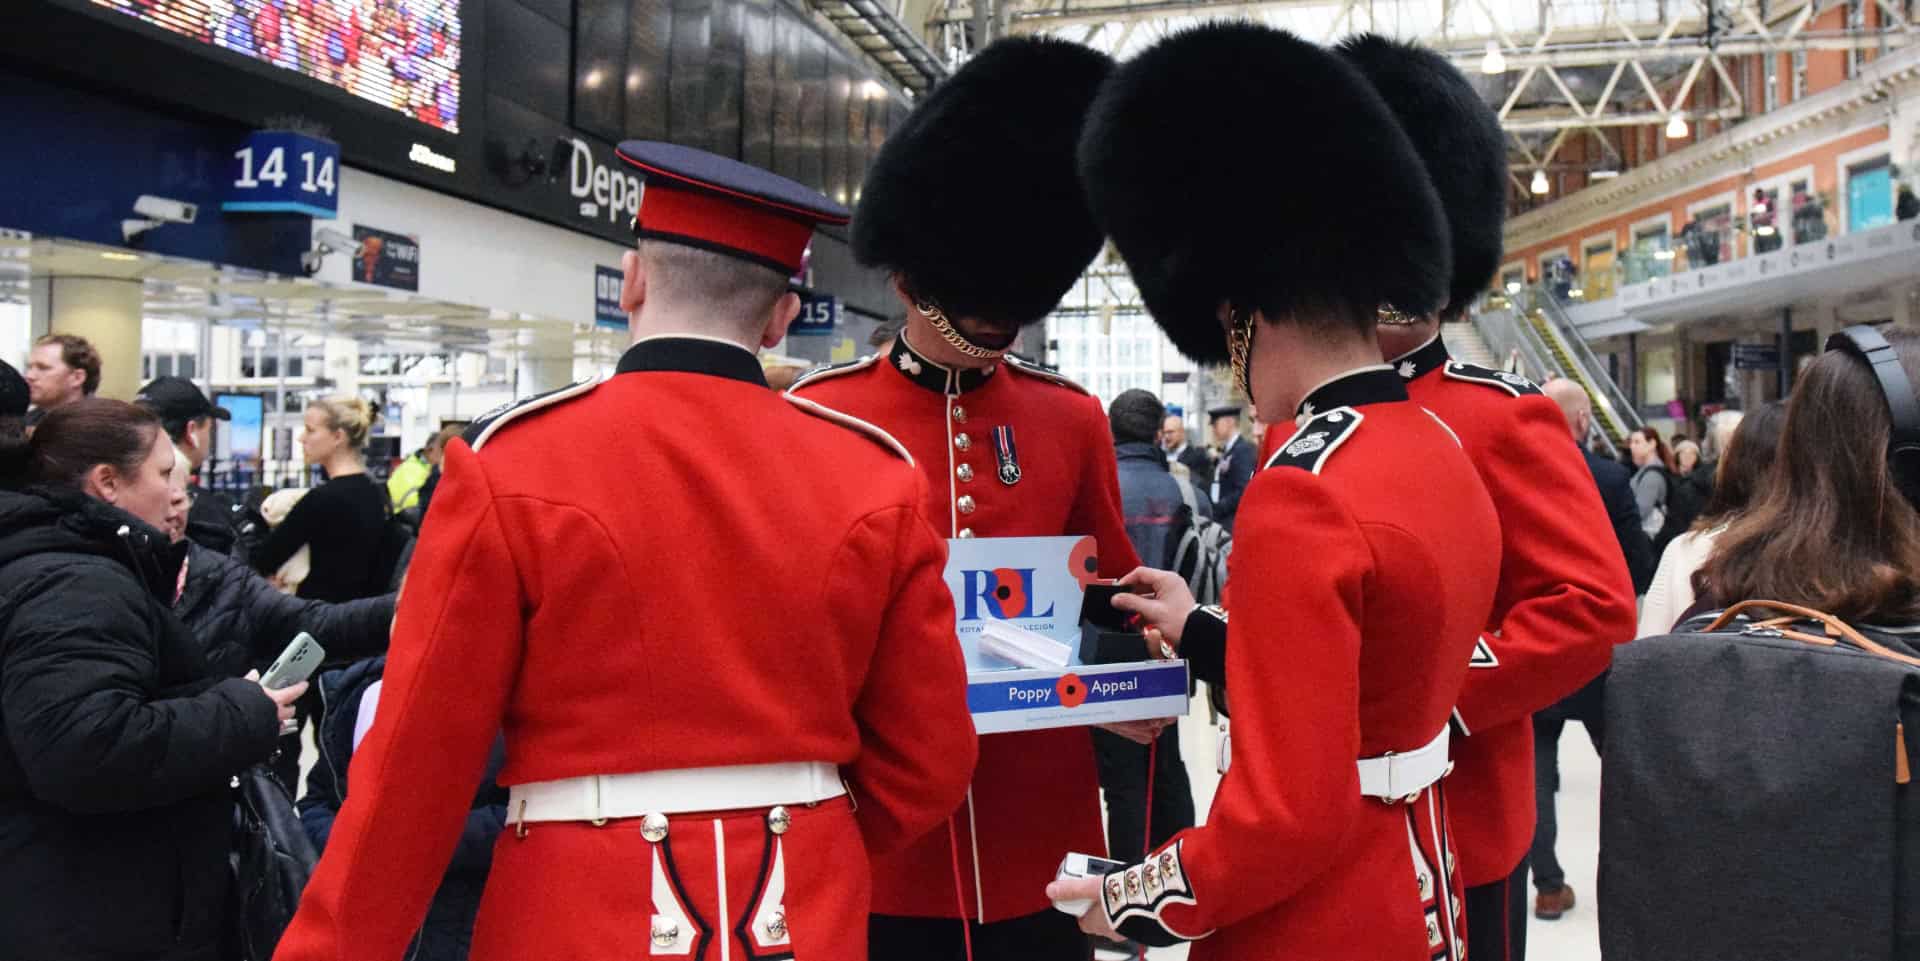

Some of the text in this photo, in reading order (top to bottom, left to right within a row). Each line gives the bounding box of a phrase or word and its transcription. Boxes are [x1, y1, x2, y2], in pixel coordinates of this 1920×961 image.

[234, 147, 287, 188] 14
[301, 151, 335, 196] 14
[803, 302, 829, 323] 15
[1009, 676, 1137, 704] Poppy Appeal
